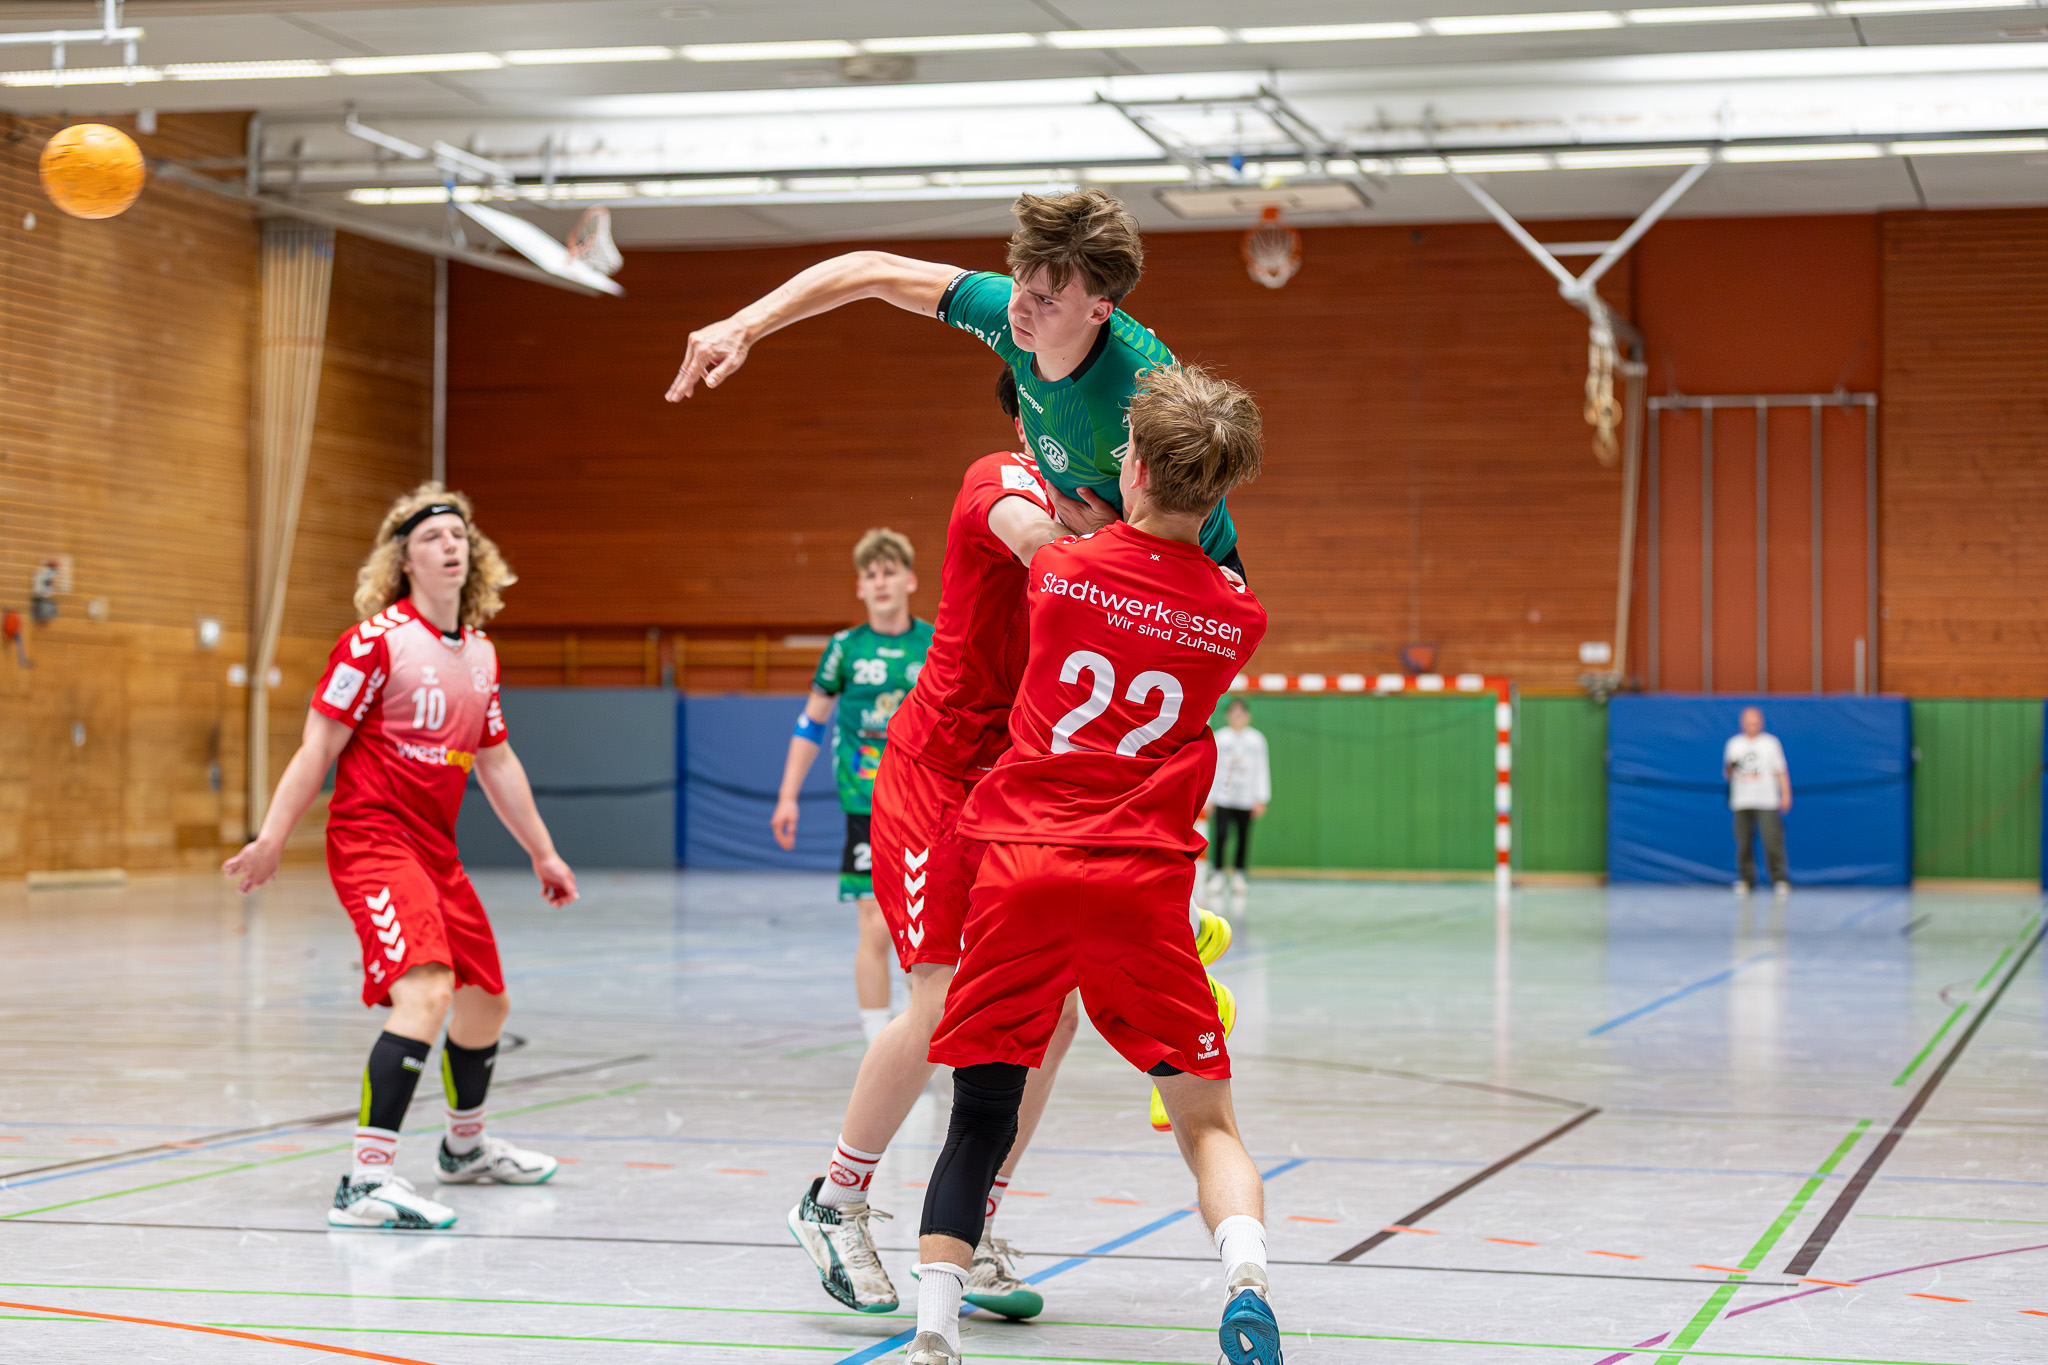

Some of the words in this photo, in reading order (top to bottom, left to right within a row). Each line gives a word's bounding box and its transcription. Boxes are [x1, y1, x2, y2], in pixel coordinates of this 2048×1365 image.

[1018, 384, 1044, 414] Kempa
[1041, 573, 1242, 644] Stadtwerkessen
[1107, 612, 1134, 630] Wir
[1138, 623, 1172, 641] sind
[1176, 631, 1237, 660] Zuhause.
[412, 687, 446, 731] 10
[1050, 650, 1184, 757] 22
[1197, 1047, 1219, 1060] hummel
